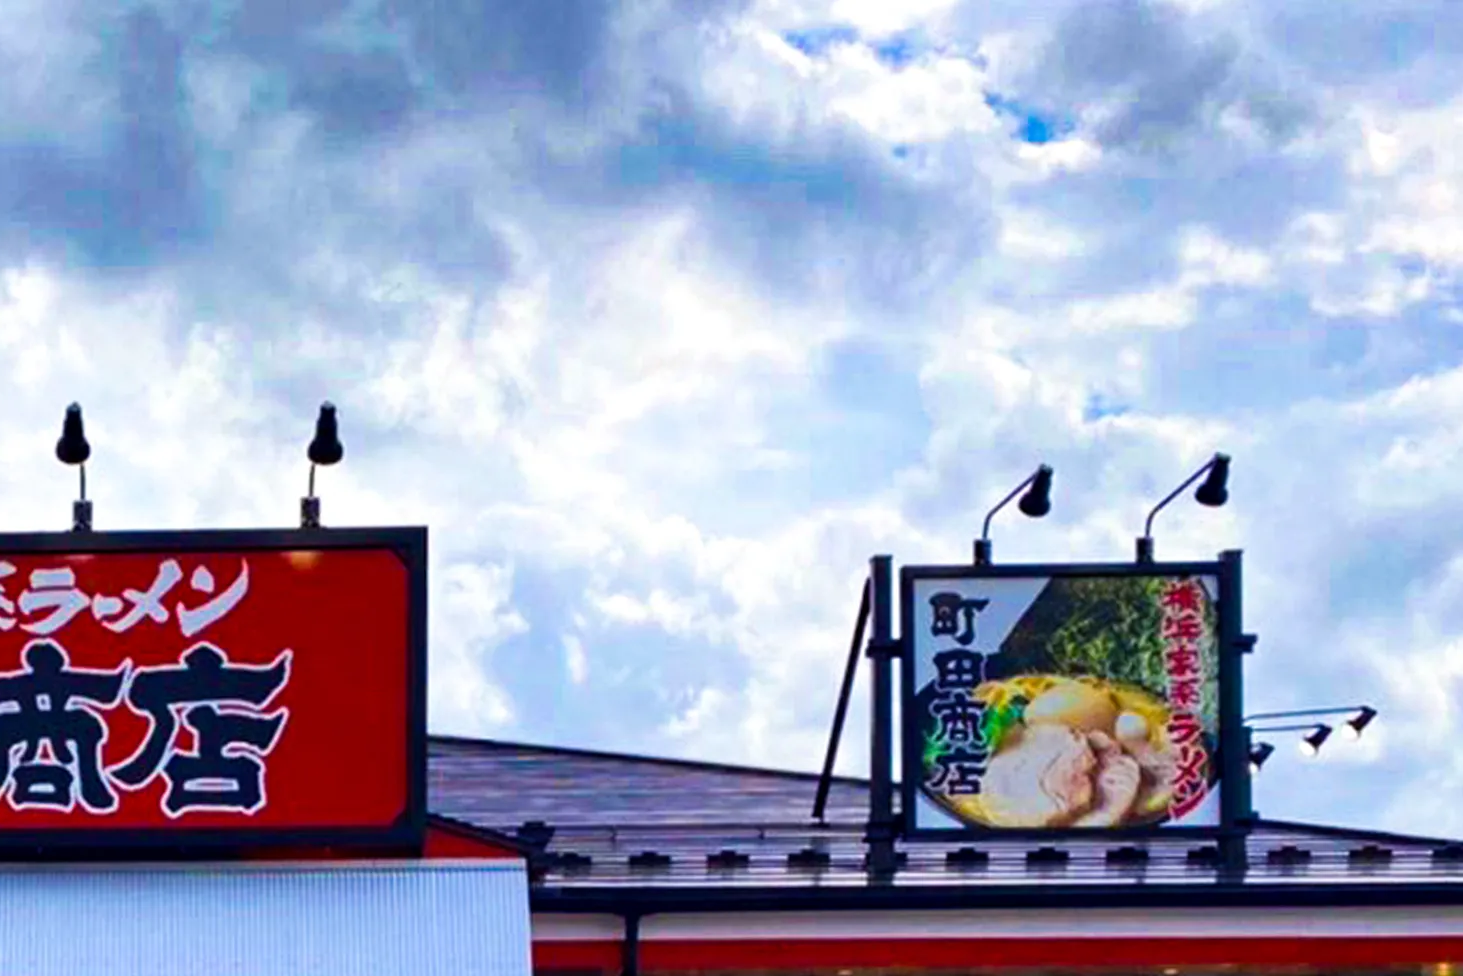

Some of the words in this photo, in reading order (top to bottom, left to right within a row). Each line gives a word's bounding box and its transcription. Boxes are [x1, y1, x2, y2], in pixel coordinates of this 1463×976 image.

[927, 592, 990, 796] 町田商店
[1160, 577, 1209, 820] 横浜家系ラーメン
